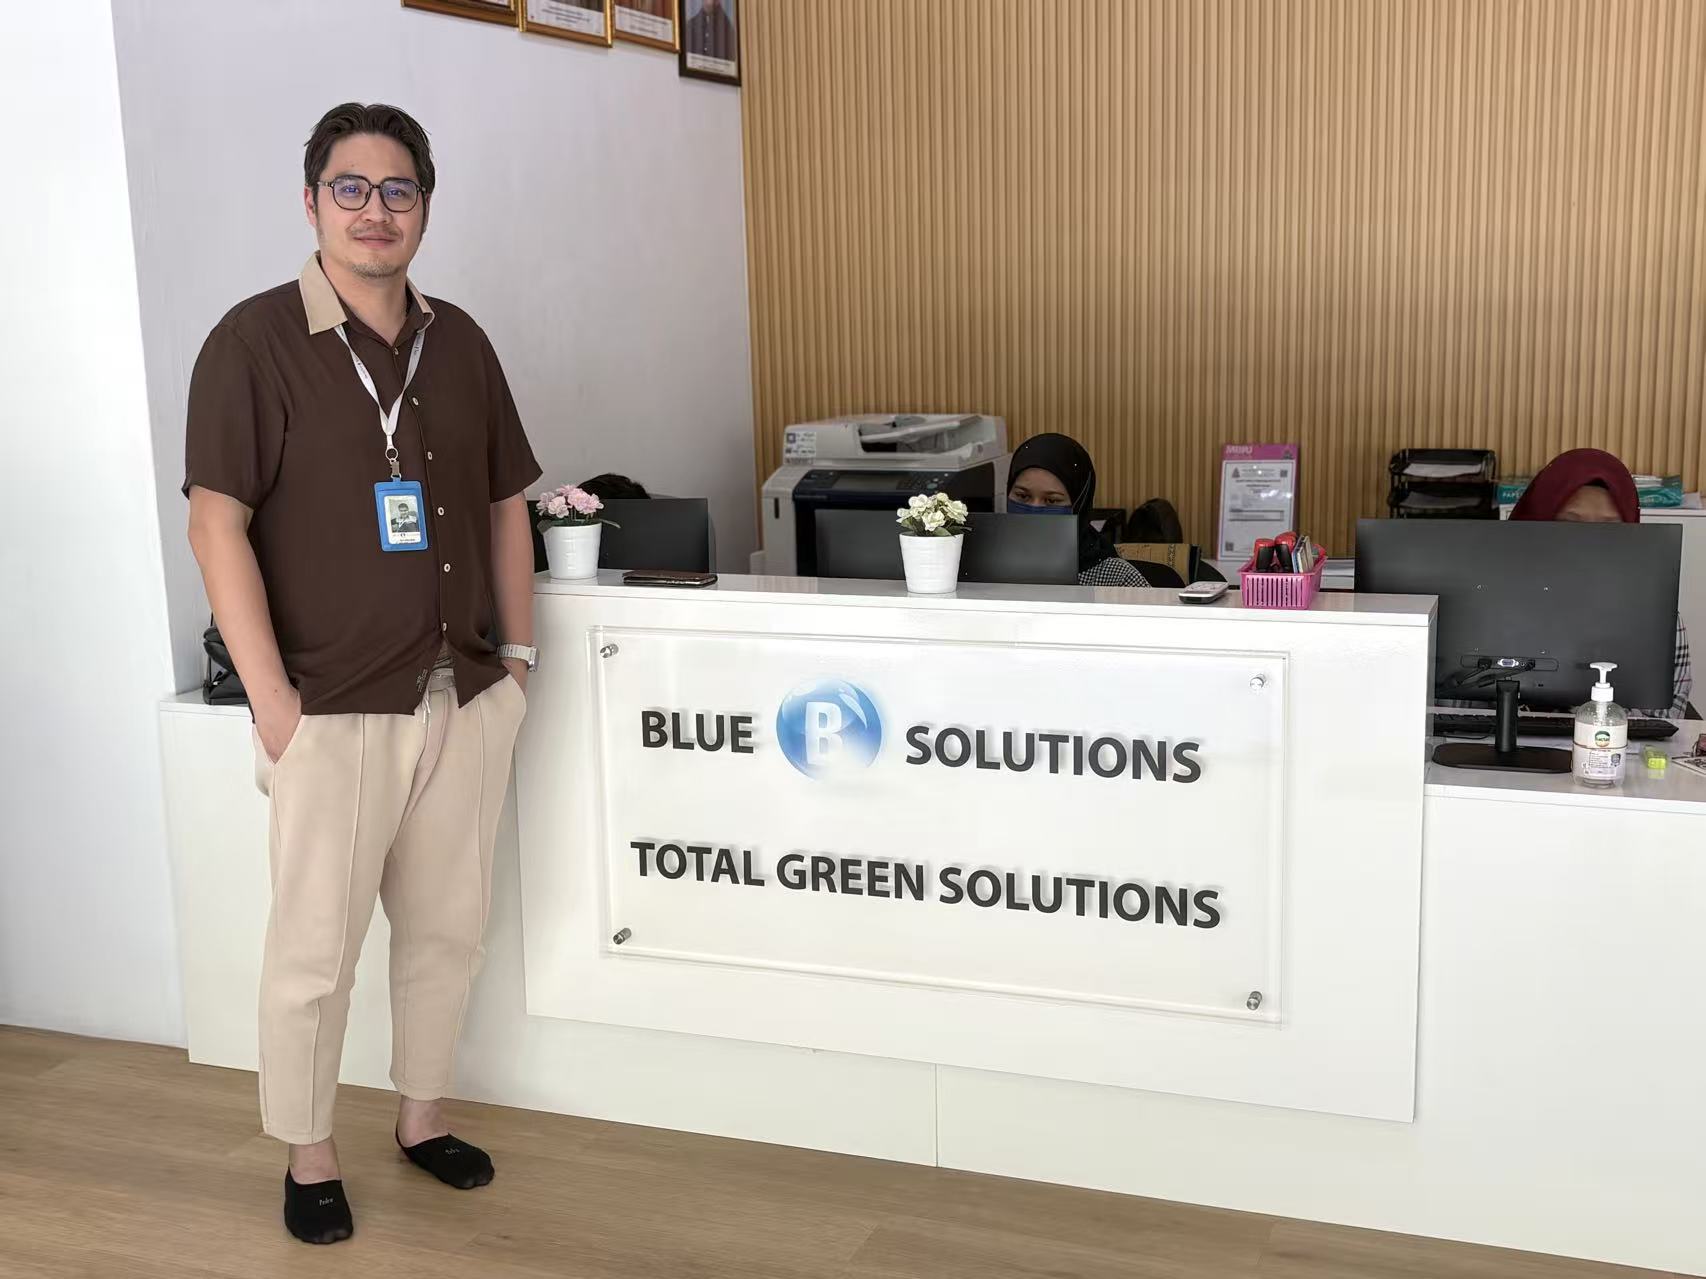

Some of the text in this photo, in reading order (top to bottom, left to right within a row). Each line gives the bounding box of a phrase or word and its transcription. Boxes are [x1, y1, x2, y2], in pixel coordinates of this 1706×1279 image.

[641, 701, 1202, 784] BLUE B SOLUTIONS
[631, 841, 1222, 929] TOTAL GREEN SOLUTIONS
